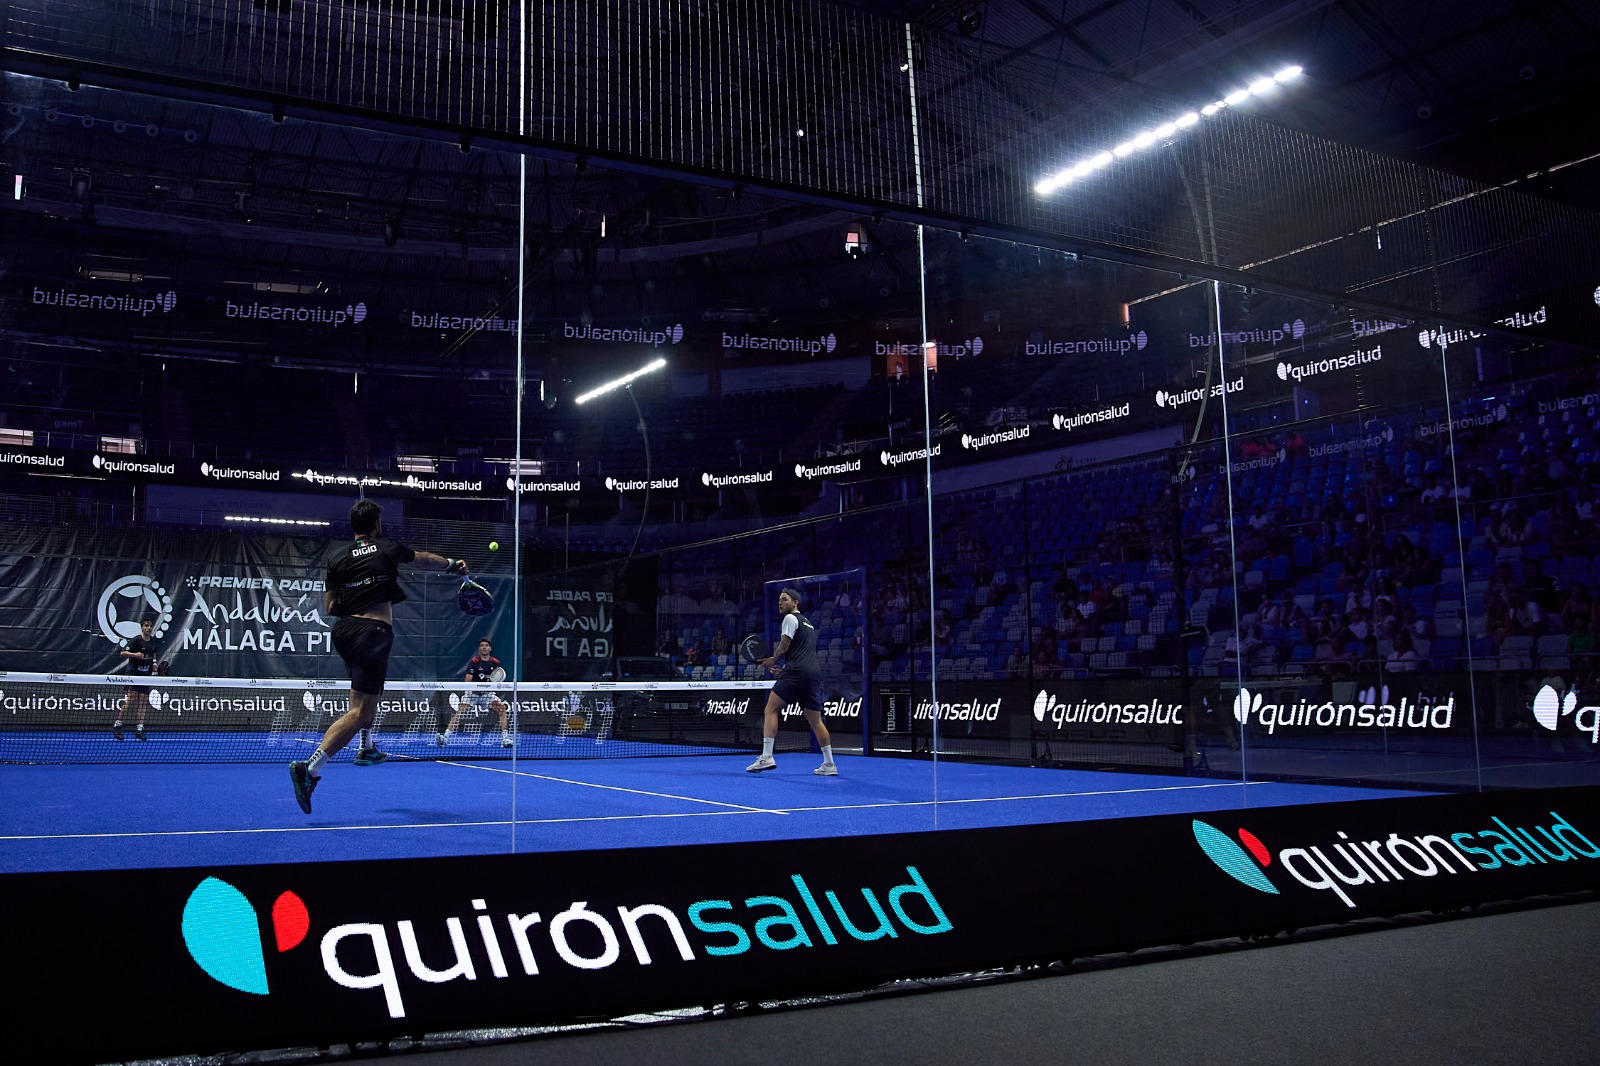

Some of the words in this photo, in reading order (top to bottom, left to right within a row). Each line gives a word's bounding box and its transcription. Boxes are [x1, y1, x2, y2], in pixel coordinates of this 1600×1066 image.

[1291, 345, 1383, 382] quirónsalud
[1063, 402, 1130, 431] quirónsalud
[971, 425, 1030, 451] quirónsalud
[0, 453, 64, 467] uirónsalud
[104, 461, 175, 475] quirónsalud
[889, 444, 941, 468] quirónsaud
[211, 468, 280, 481] quirónsalud
[712, 471, 773, 488] quirónsalud
[804, 459, 861, 480] quirónsalud
[352, 545, 378, 557] DIGIO
[199, 576, 273, 590] PREMIER
[185, 590, 330, 627] Andalucía
[183, 624, 296, 652] MÁLAGA
[307, 631, 331, 653] P1
[168, 695, 285, 716] quirónsalud
[1258, 690, 1454, 735] quirónsalud
[1279, 811, 1600, 908] quirónsalud
[319, 865, 955, 1018] quirónsalud
